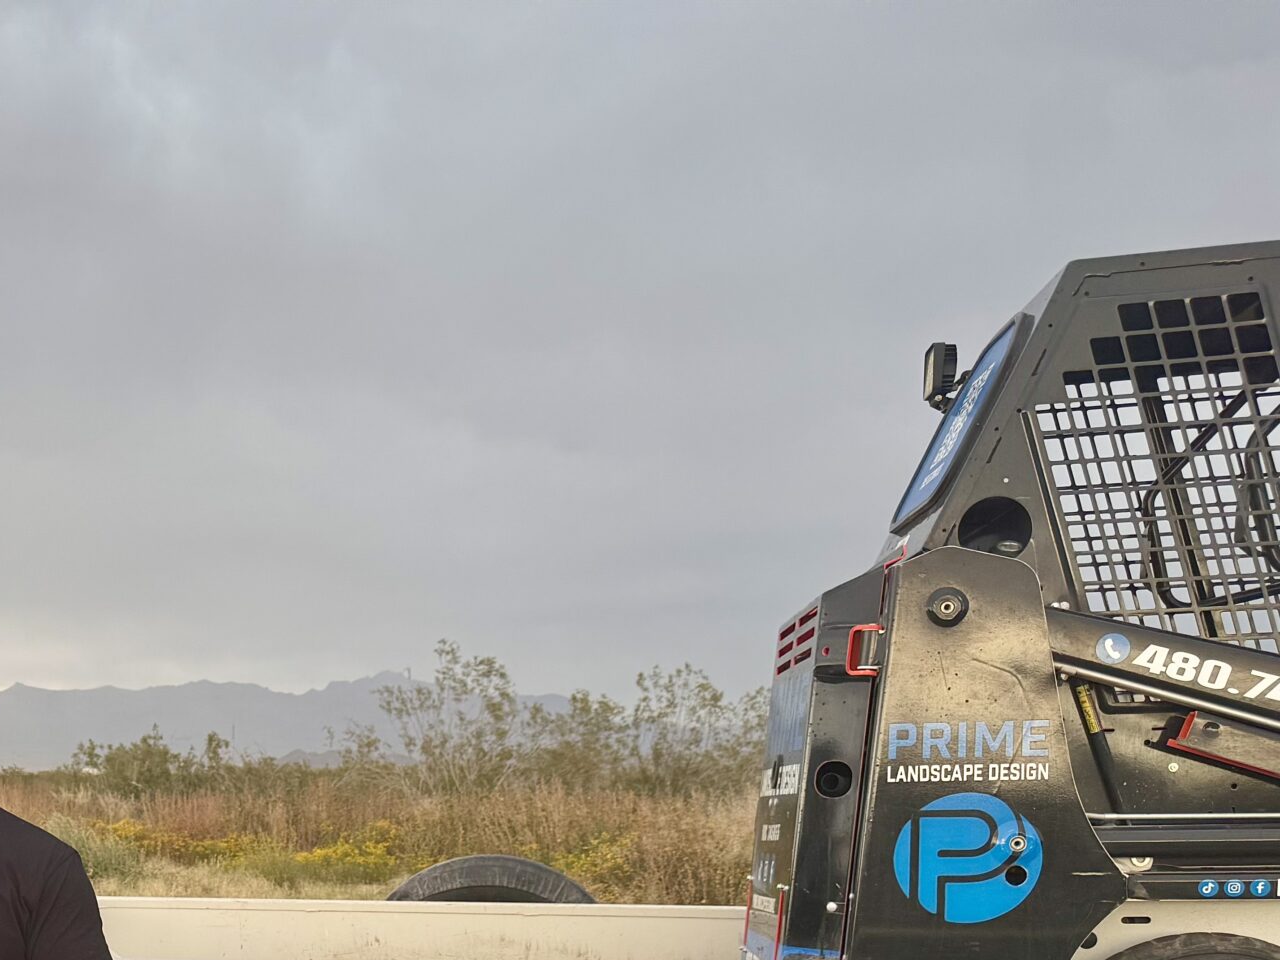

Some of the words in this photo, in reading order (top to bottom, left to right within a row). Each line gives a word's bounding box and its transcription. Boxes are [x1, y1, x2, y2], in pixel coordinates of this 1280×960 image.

[887, 719, 1051, 760] PRIME
[886, 763, 984, 783] LANDSCAPE
[988, 762, 1049, 781] DESIGN
